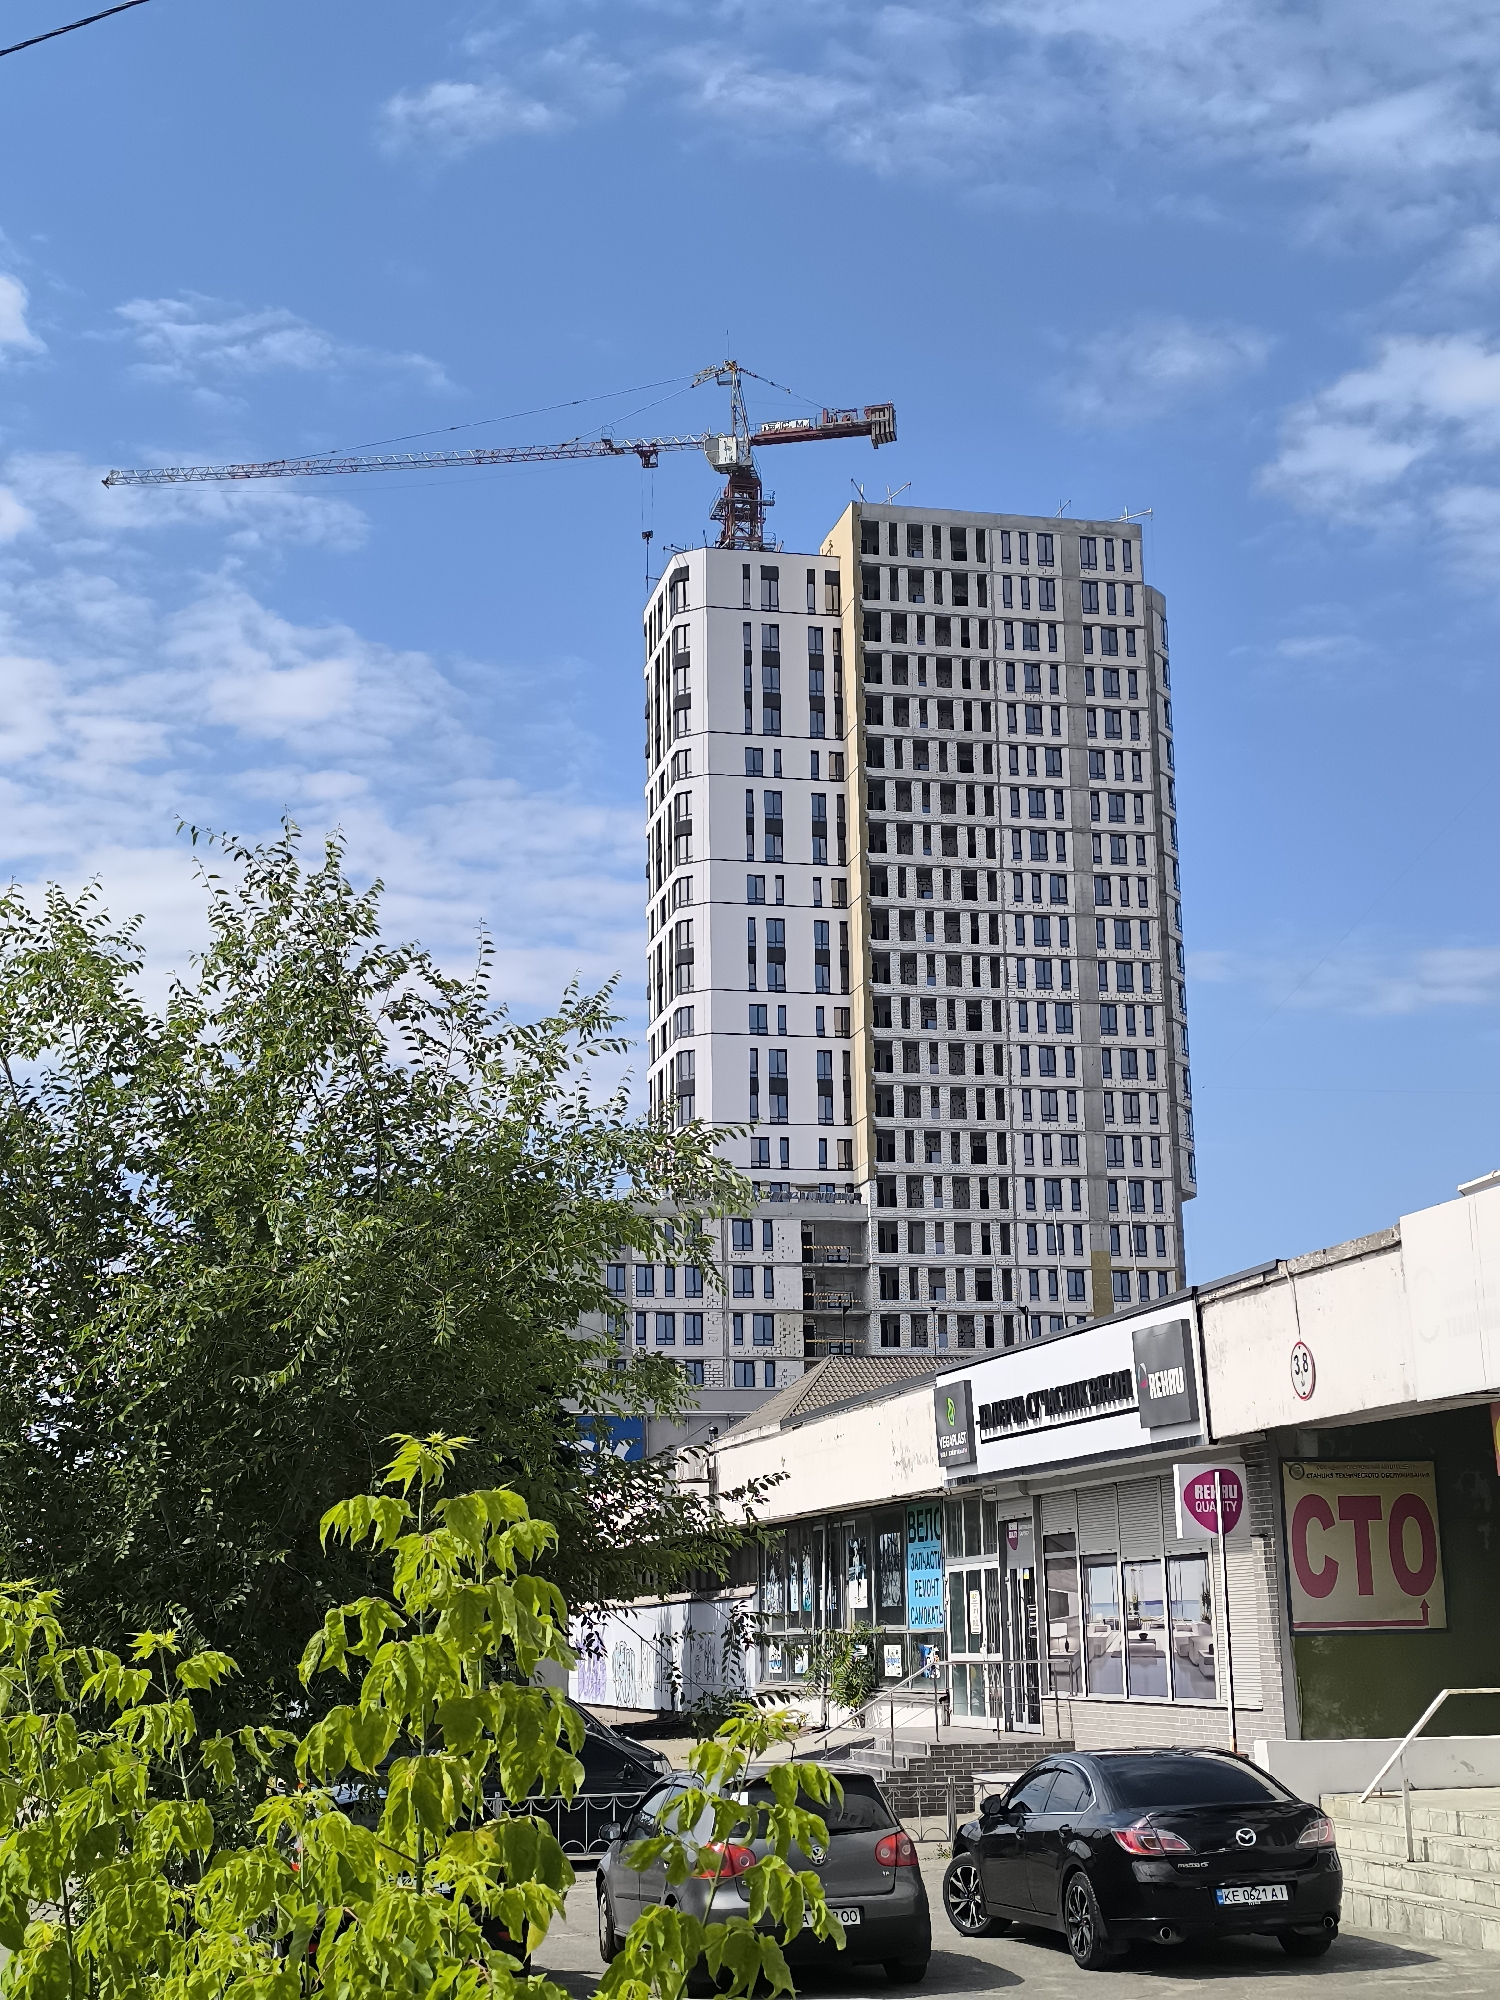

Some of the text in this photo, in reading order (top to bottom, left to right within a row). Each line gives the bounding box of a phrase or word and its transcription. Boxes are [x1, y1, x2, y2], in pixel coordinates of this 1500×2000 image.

[1147, 1366, 1185, 1399] REHAU
[1195, 1501, 1238, 1512] QUAITY
[1291, 1493, 1438, 1599] СТО
[914, 1578, 940, 1597] РЕМОНТ
